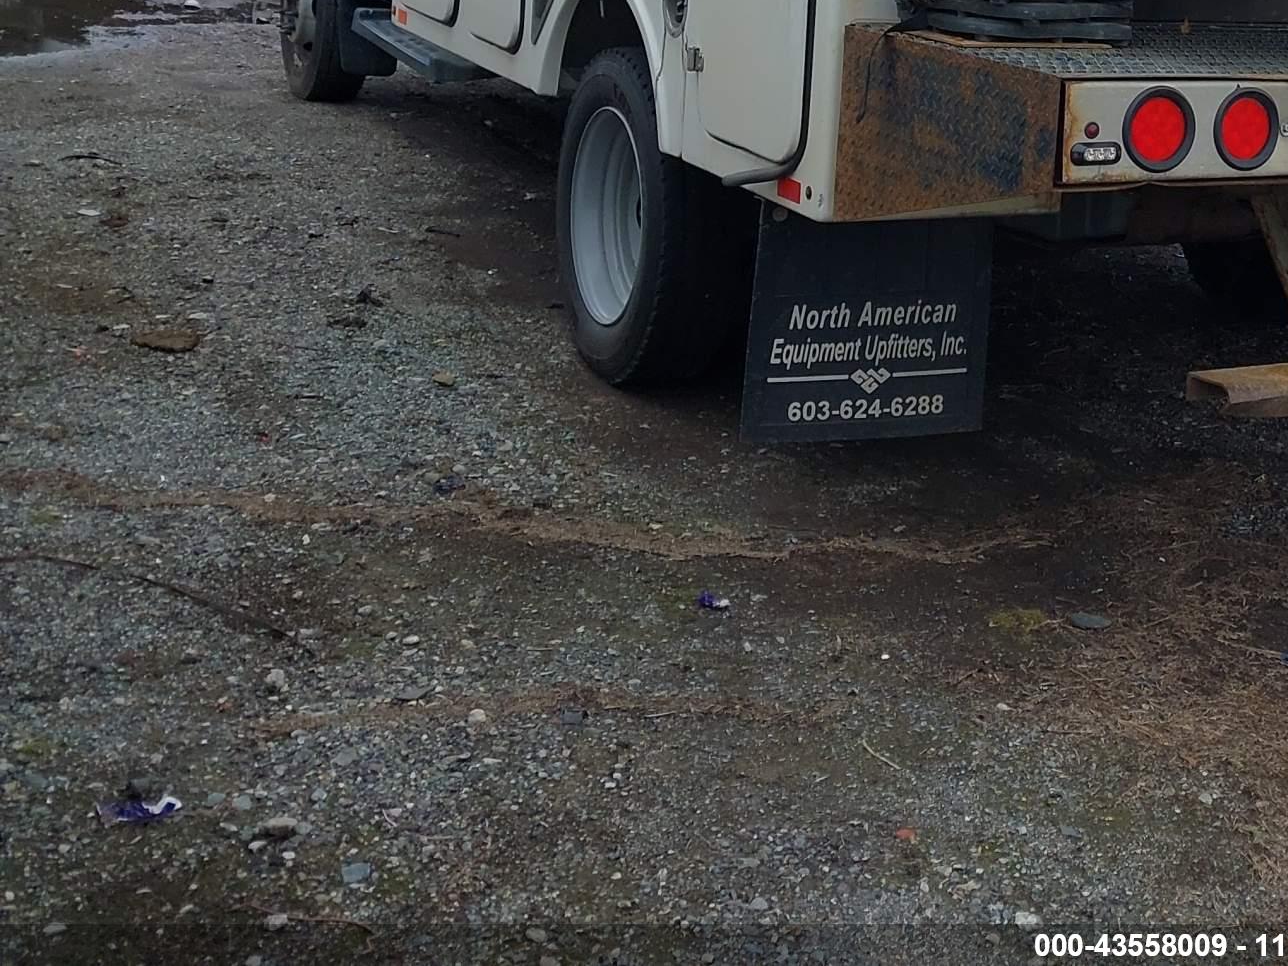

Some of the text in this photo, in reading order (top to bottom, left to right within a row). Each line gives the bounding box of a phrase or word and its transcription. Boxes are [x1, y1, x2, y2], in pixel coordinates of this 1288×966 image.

[788, 300, 957, 331] North American
[770, 331, 967, 370] Equipment Upfitters, Inc.
[787, 394, 944, 422] 603-624-6288
